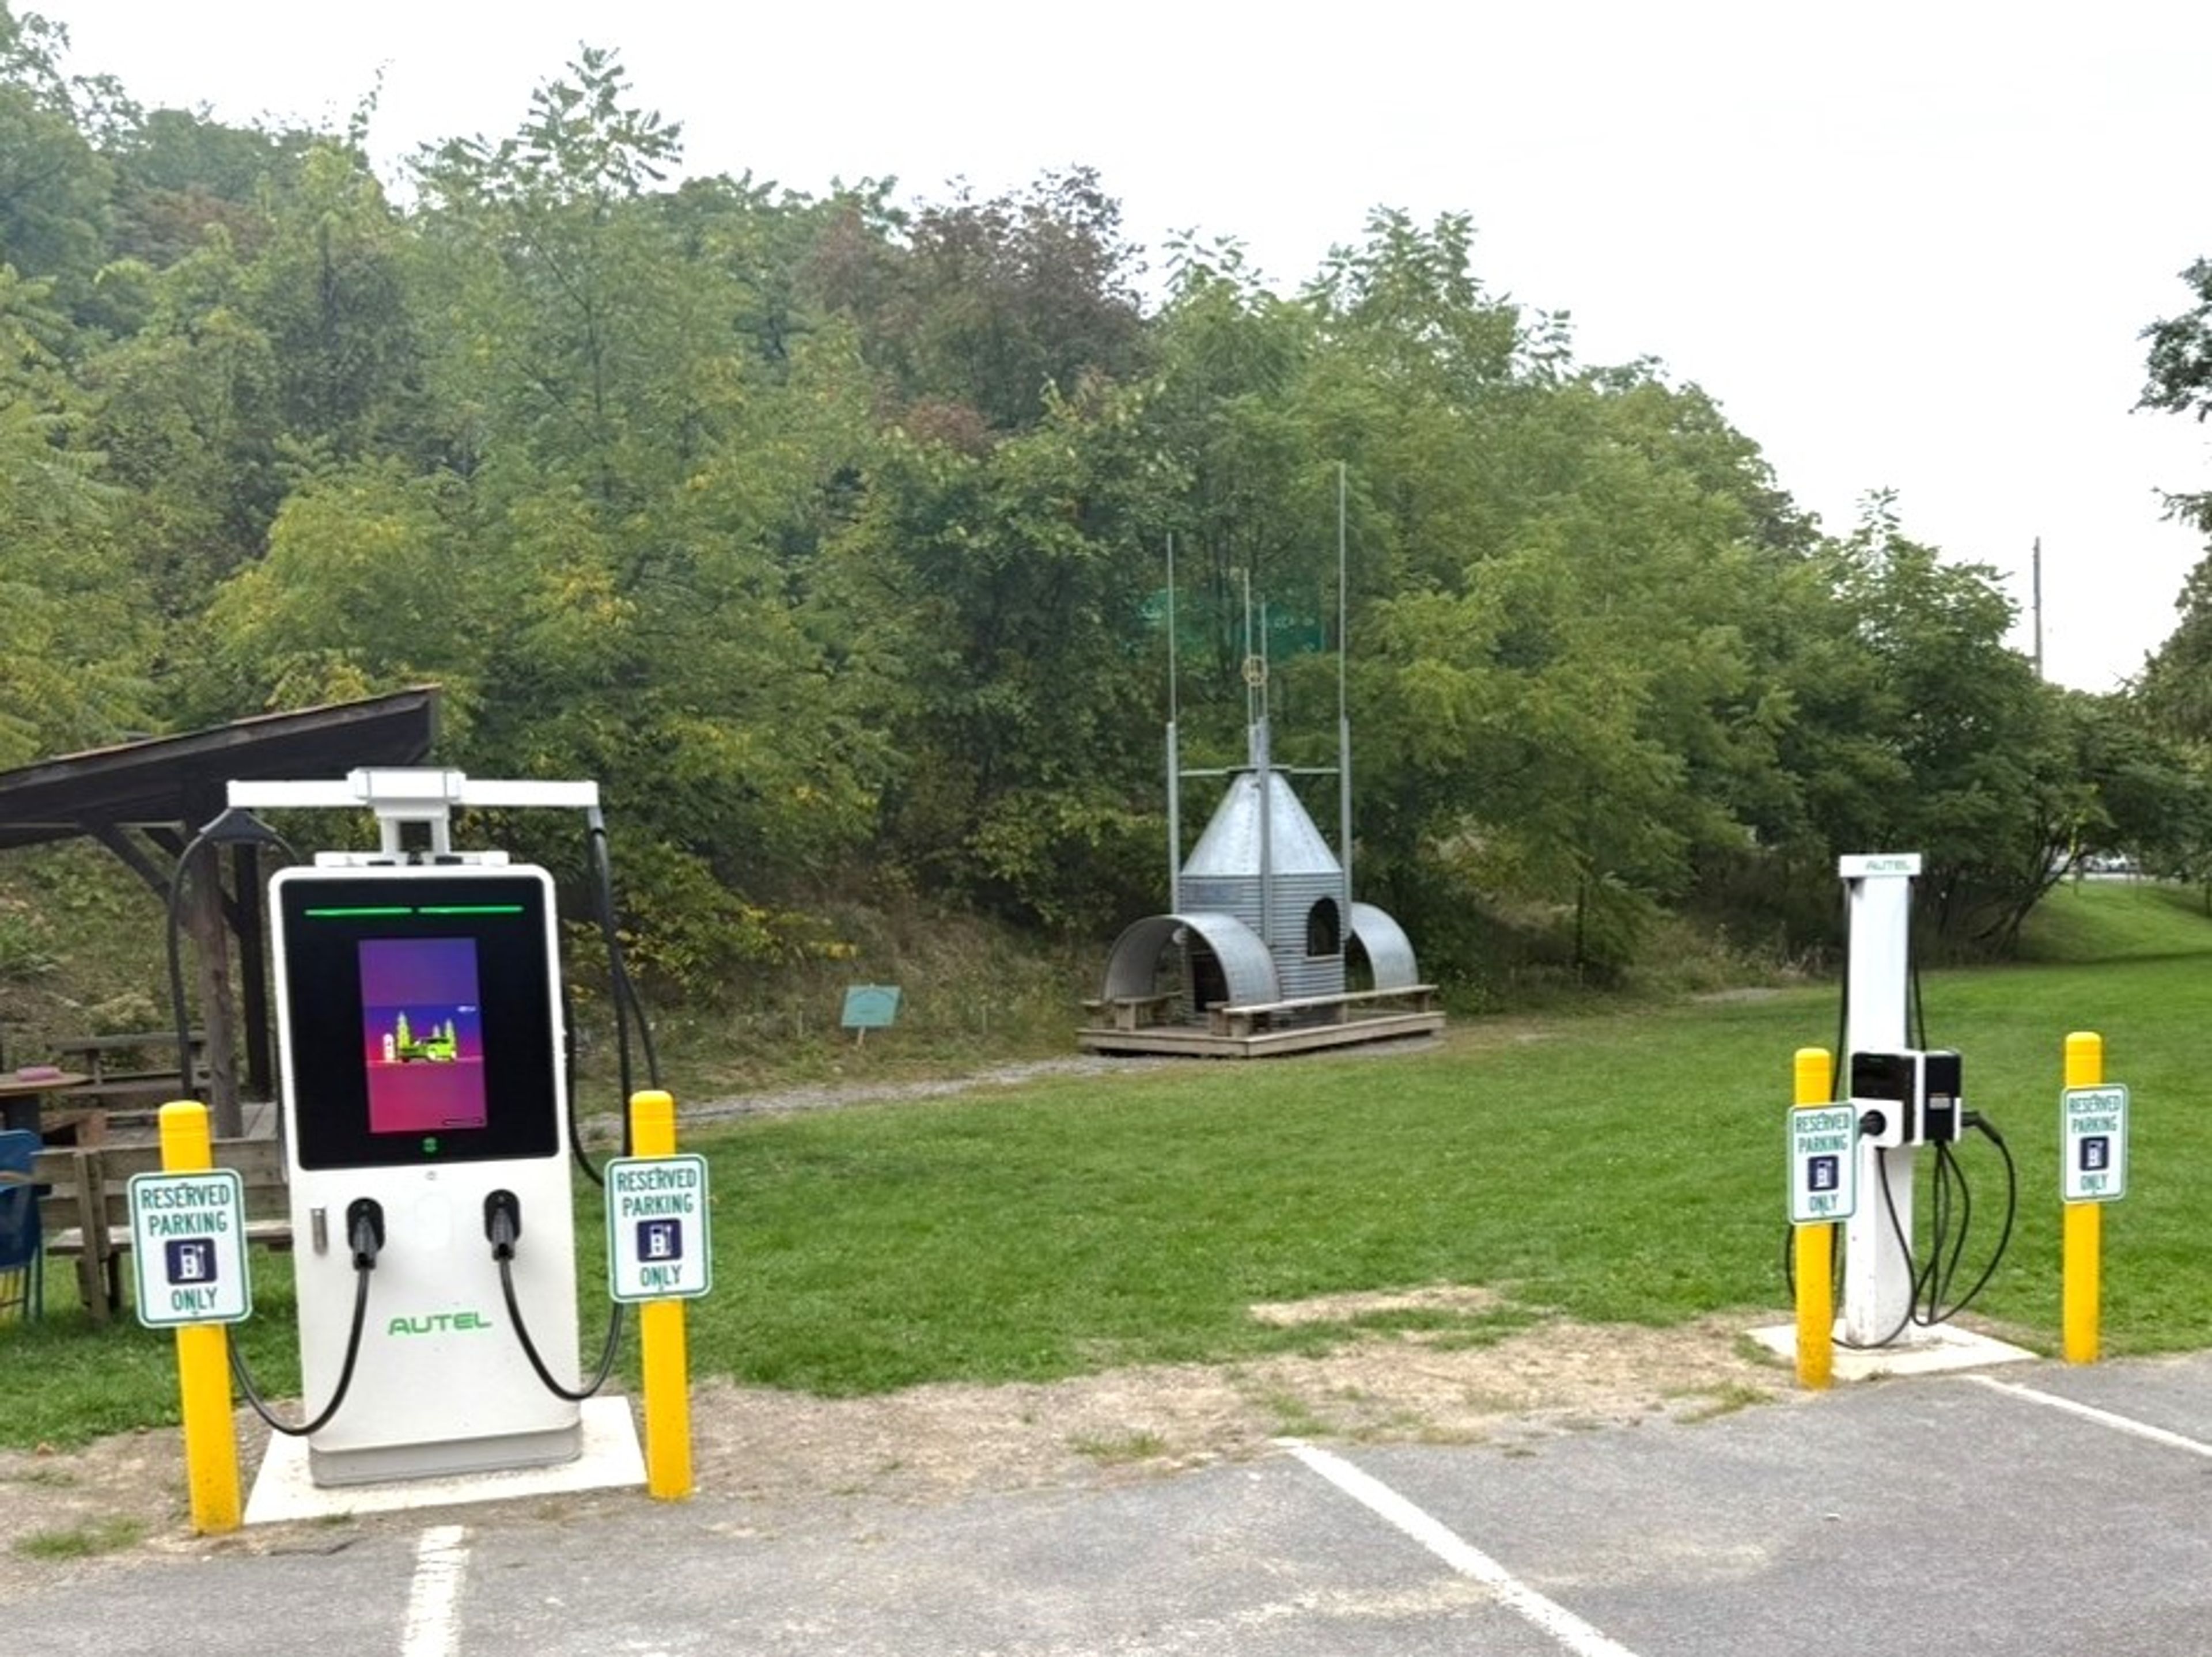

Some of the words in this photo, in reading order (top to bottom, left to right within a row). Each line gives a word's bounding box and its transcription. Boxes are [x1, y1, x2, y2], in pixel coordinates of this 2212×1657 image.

[1866, 860, 1912, 870] AUTEL
[2068, 1095, 2120, 1114] RESERVED
[1796, 1112, 1849, 1133] RESERVED
[2072, 1114, 2116, 1133] PARKING
[1798, 1133, 1848, 1154] PARKING
[616, 1168, 697, 1192] RESERVED
[2081, 1173, 2108, 1190] ONLY
[141, 1184, 230, 1209] RESERVED
[622, 1194, 694, 1217] PARKING
[1809, 1193, 1839, 1212] ONLY
[148, 1211, 228, 1236] PARKING
[639, 1265, 682, 1287] ONLY
[171, 1287, 217, 1311] ONLY
[388, 1311, 493, 1336] AUTEL
